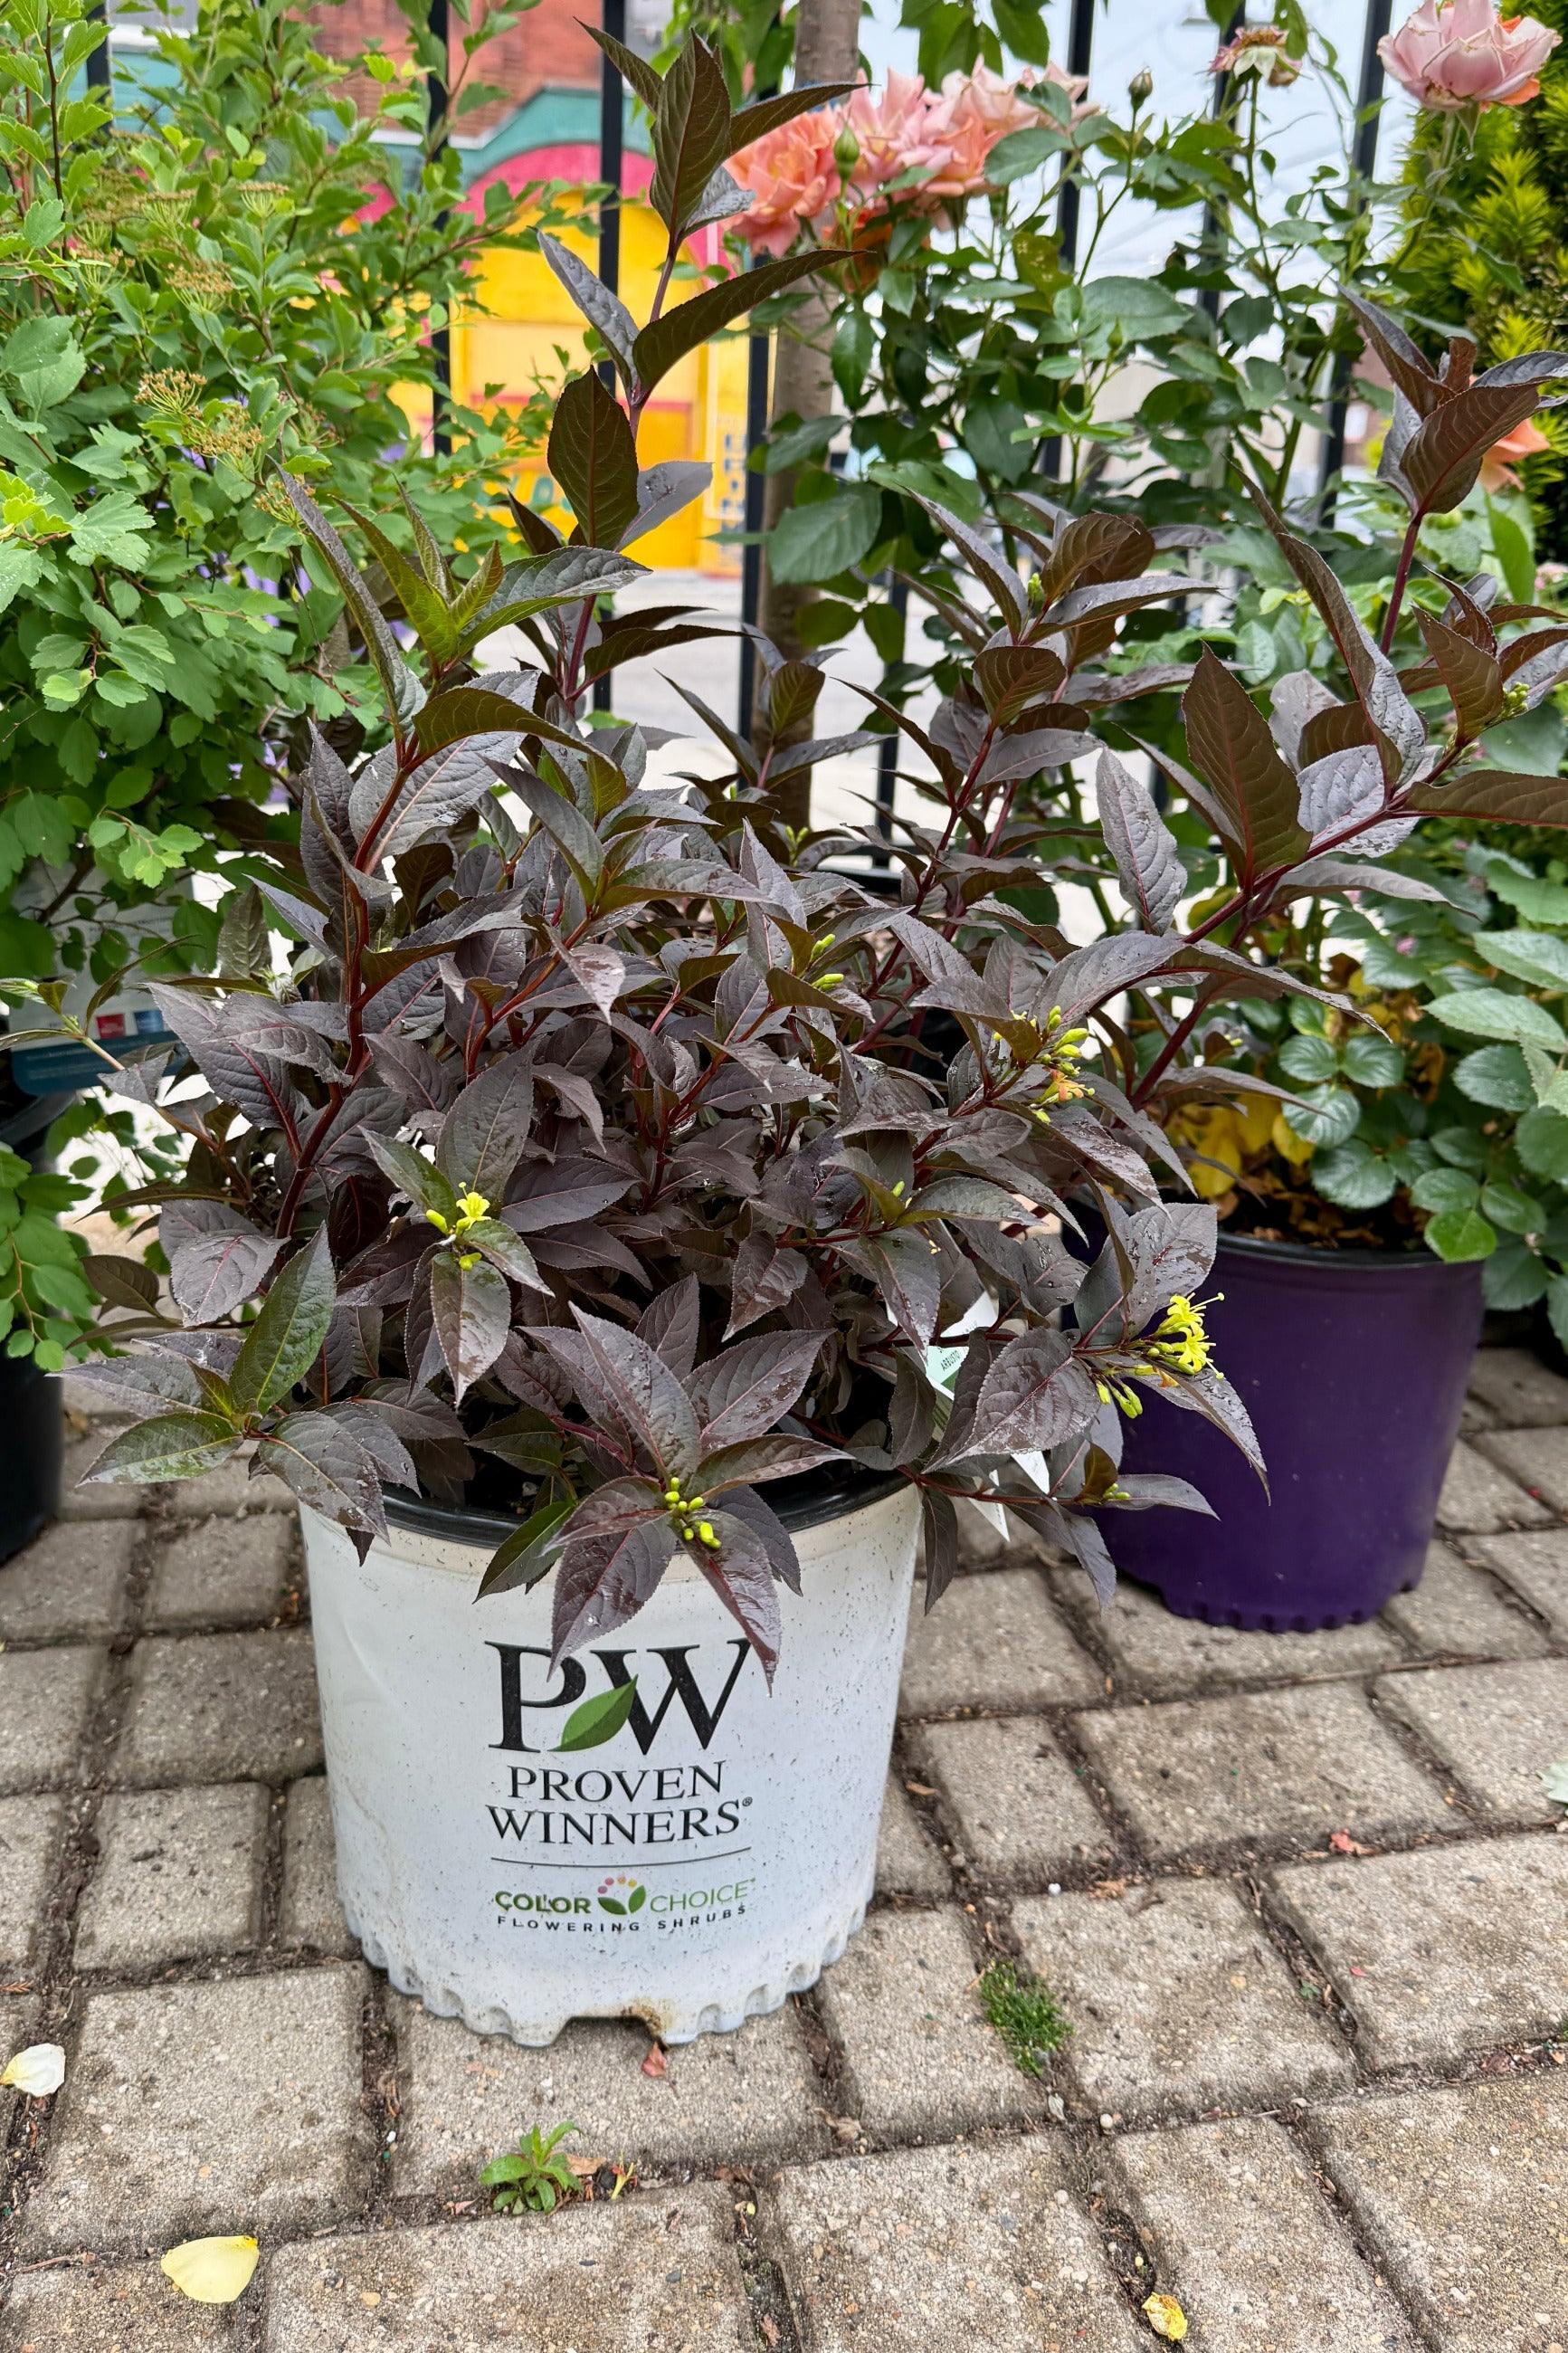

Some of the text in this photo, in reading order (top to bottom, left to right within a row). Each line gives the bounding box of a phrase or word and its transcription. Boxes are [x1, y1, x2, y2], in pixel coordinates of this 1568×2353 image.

[484, 1637, 753, 1756] PW
[507, 1760, 727, 1803] PROVEN
[494, 1891, 592, 1914] COLOR
[498, 1905, 746, 1932] FLOWERING SHRUBS
